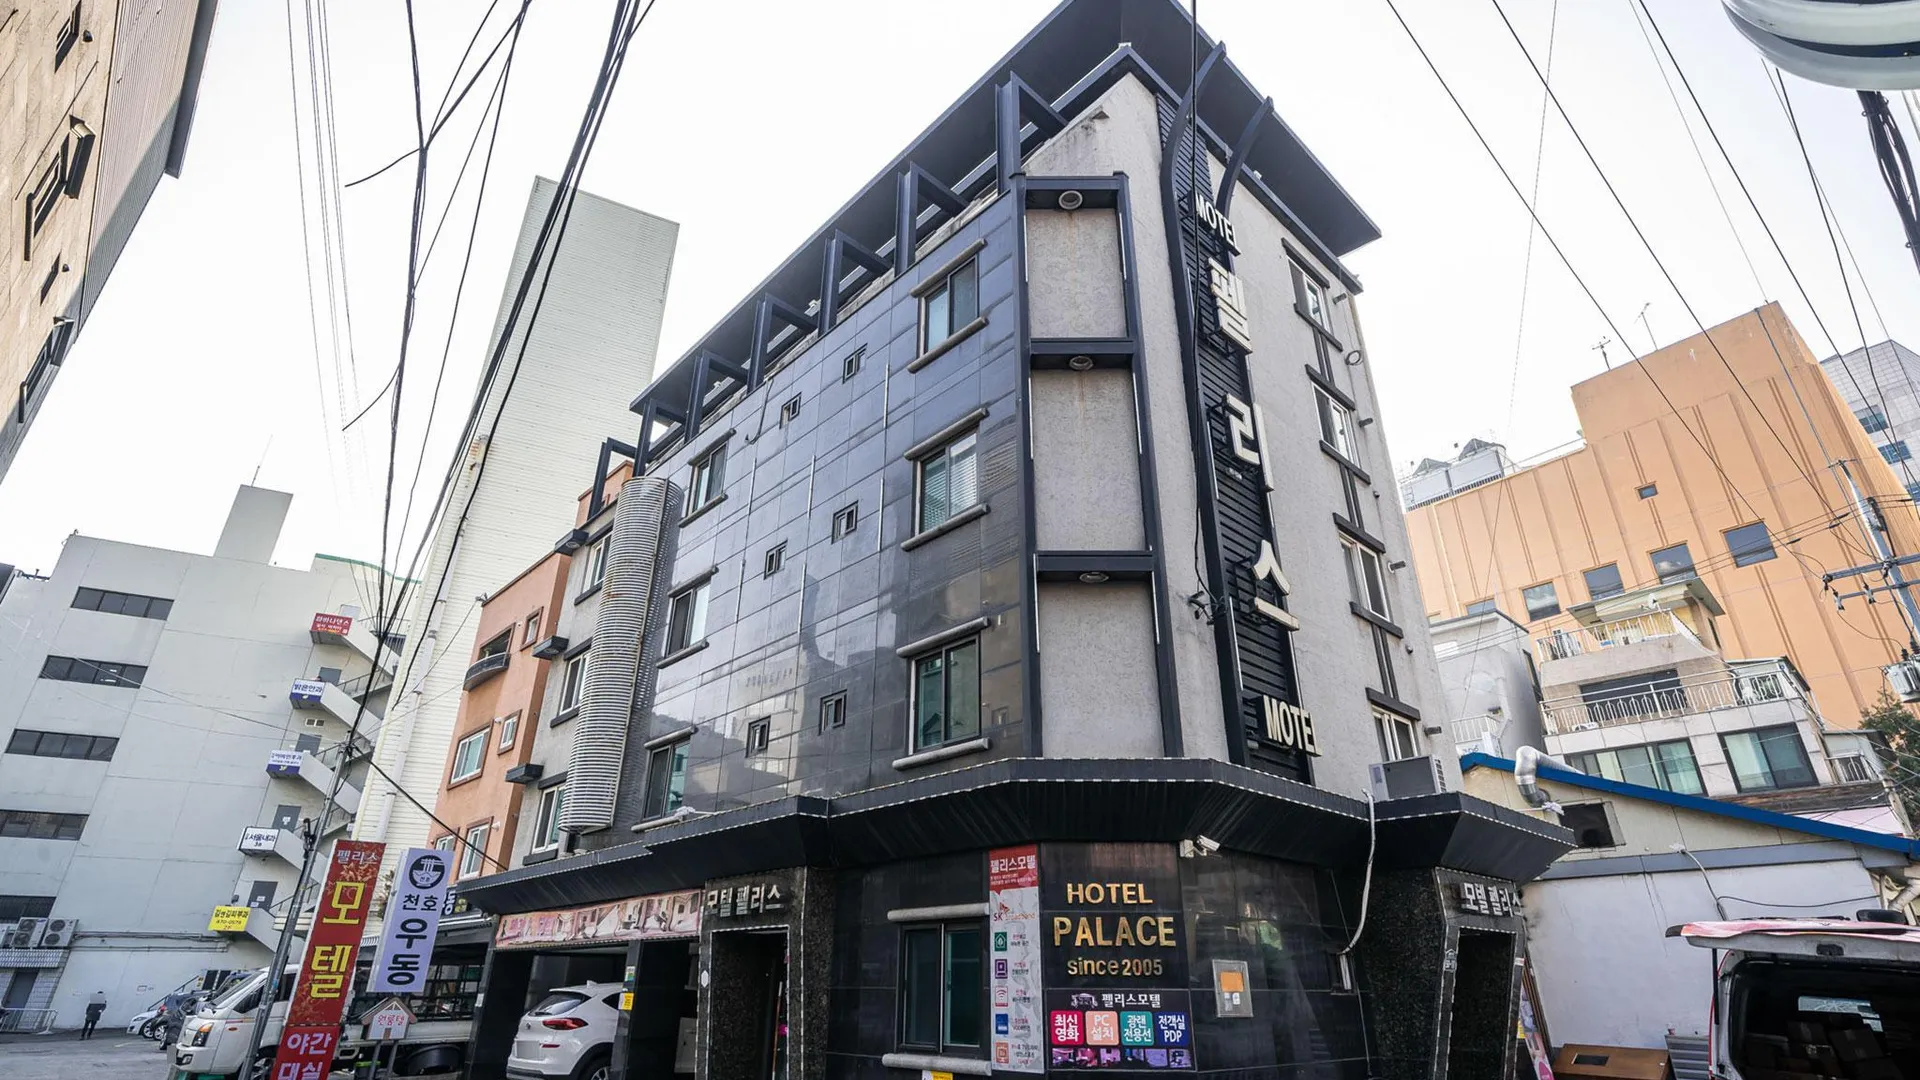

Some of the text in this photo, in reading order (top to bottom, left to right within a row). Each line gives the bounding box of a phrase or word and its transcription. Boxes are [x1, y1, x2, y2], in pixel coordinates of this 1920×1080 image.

[1195, 193, 1240, 256] MOTEL
[1263, 694, 1322, 757] MOTEL
[1067, 883, 1153, 904] HOTEL
[402, 893, 438, 911] 천호
[993, 912, 1003, 921] SK
[1053, 915, 1176, 947] PALACE
[310, 881, 366, 998] 모텔
[387, 918, 428, 986] 우동
[1067, 957, 1163, 976] since 2005
[1101, 993, 1161, 1008] 펠리스모텔
[1055, 1014, 1078, 1027] 최신
[1094, 1014, 1110, 1026] PC
[1127, 1015, 1146, 1029] 광랜
[1159, 1015, 1185, 1030] 전객실
[1055, 1027, 1079, 1042] 영화
[1091, 1027, 1113, 1040] 설치
[1124, 1028, 1152, 1042] 전용선
[1164, 1030, 1182, 1043] PDP
[287, 1032, 332, 1055] 야간
